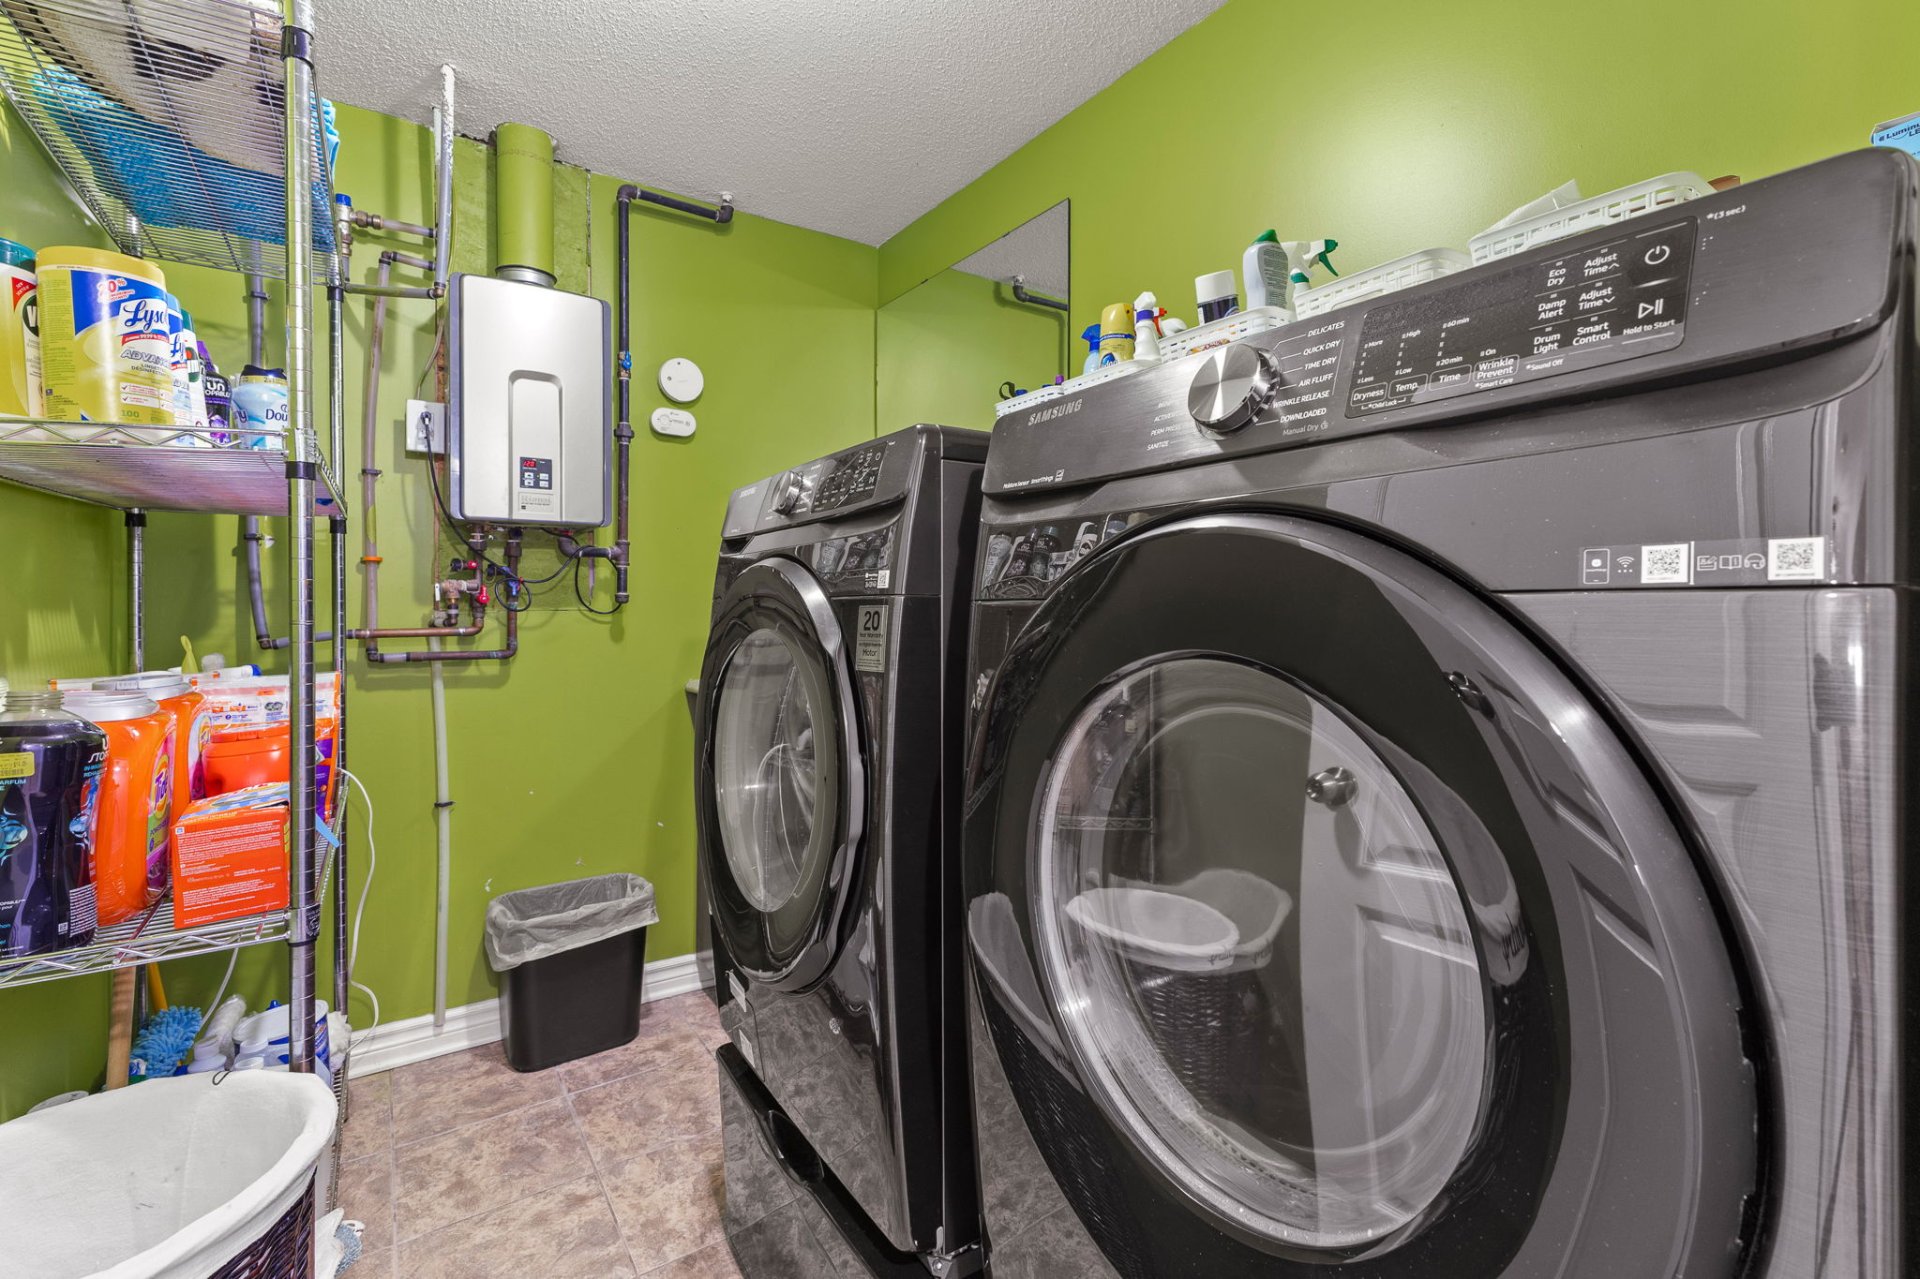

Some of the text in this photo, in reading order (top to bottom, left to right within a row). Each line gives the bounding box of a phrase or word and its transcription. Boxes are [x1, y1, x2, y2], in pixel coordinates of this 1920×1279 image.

[1584, 253, 1618, 268] Adjust
[1549, 268, 1566, 278] Eco
[1584, 265, 1608, 277] Time
[1547, 277, 1566, 287] Dry
[1579, 287, 1613, 301] Adjust
[1538, 299, 1567, 312] Damp
[1578, 299, 1603, 311] Time
[1538, 308, 1563, 320] Alert
[1307, 321, 1345, 337] DELICATES
[1577, 322, 1609, 335] Smart
[1623, 319, 1675, 336] Hold to Start
[1533, 332, 1561, 345] Drum
[1573, 331, 1611, 346] Control
[1303, 340, 1341, 356] QUICK DRY
[1533, 342, 1559, 355] Light
[1304, 356, 1338, 370] TIME DRY
[1479, 358, 1514, 371] Wrinkle
[1400, 367, 1412, 375] Low
[1477, 366, 1513, 379] Prevent
[1299, 373, 1334, 387] AIR FLUFF
[1439, 373, 1461, 383] Time
[1273, 390, 1330, 408] WRINKLE RELEASE
[1353, 389, 1384, 401] Dryness
[1027, 399, 1082, 426] SAMSUNG
[1280, 408, 1327, 423] DOWNLOADED
[1283, 423, 1319, 436] Manual Dry
[863, 610, 880, 631] 20
